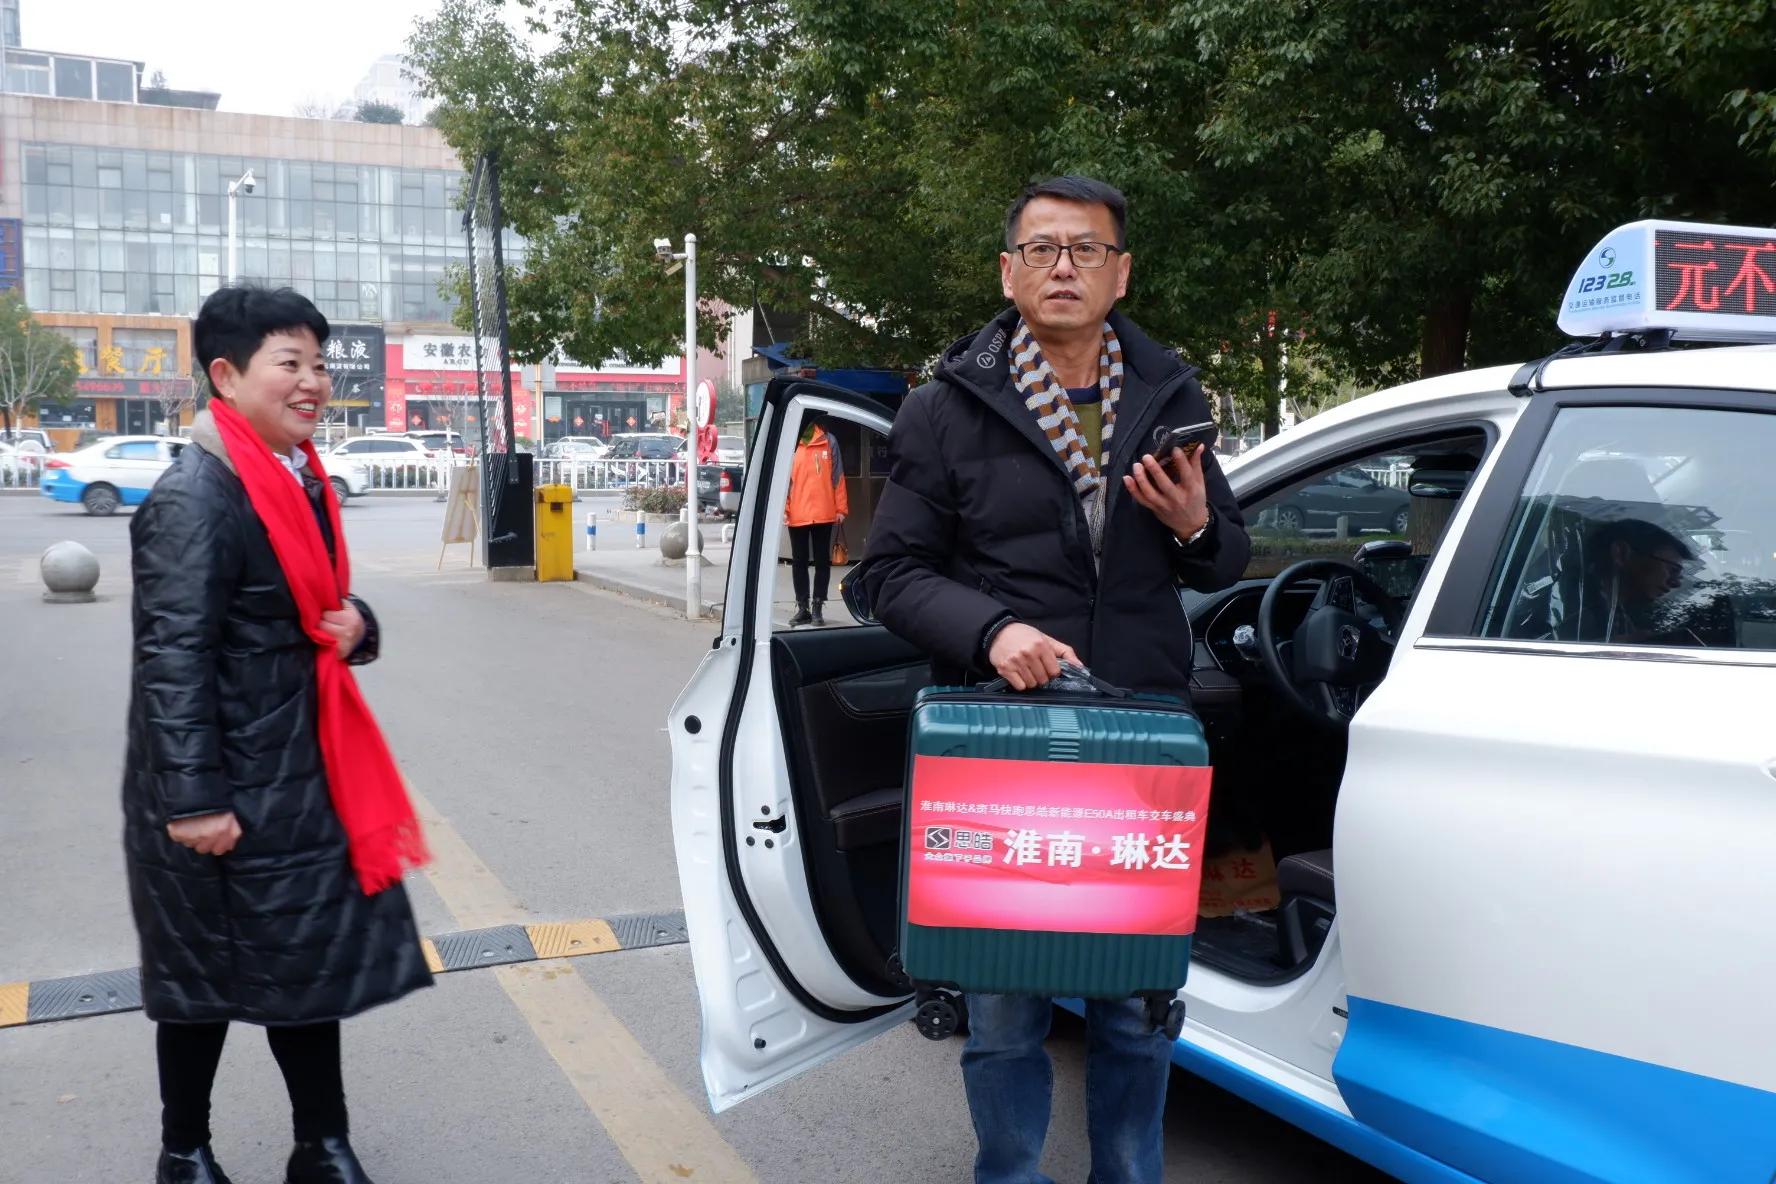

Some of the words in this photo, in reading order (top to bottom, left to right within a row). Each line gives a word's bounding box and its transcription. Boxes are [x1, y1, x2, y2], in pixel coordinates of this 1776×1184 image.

[1578, 271, 1633, 293] 12328
[954, 830, 992, 850] 思皓
[1002, 829, 1190, 870] 淮南·琳达
